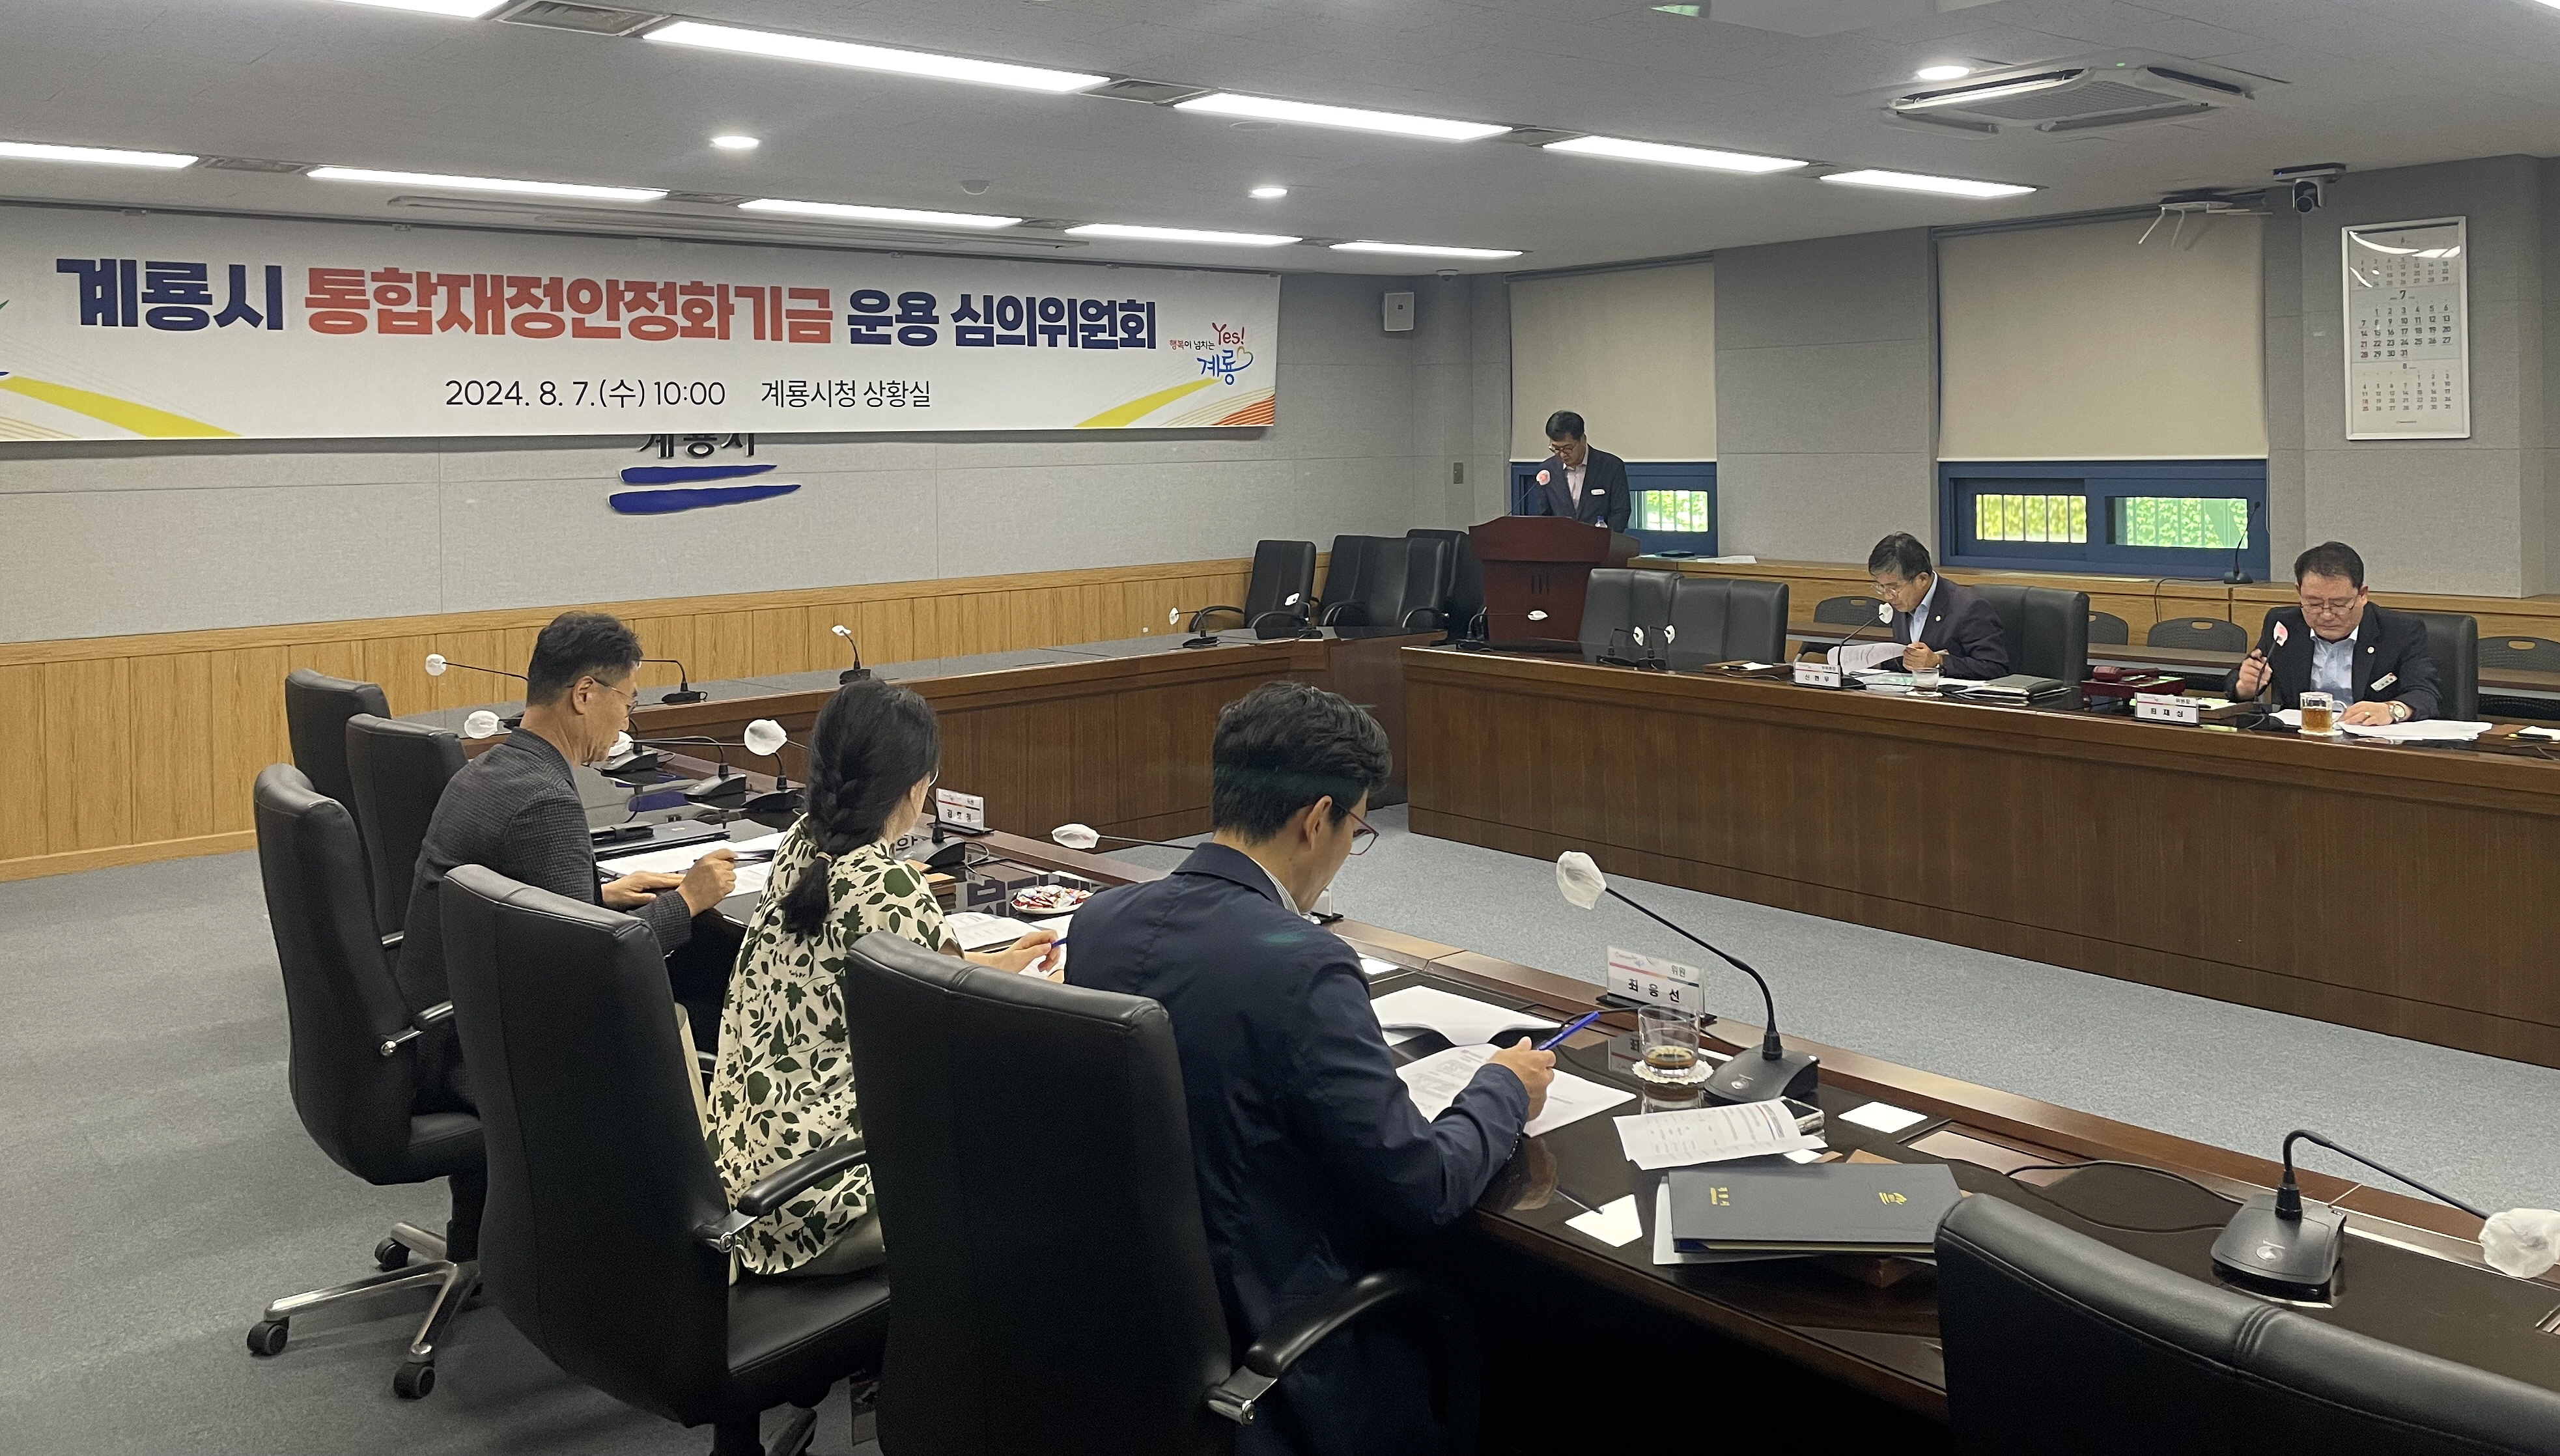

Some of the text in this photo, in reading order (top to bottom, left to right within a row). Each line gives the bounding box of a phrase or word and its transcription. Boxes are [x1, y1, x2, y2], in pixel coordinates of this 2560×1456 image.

[57, 259, 1157, 350] 계룡시 통합재정안정화기금 운용 심의위원회
[2400, 290, 2406, 299] 7
[1170, 339, 1216, 350] 행복이 넘치는
[1212, 322, 1245, 345] Yes!
[1197, 349, 1237, 385] 계룡
[445, 380, 530, 406] 2024.
[539, 381, 563, 406] 8.
[654, 381, 725, 405] 10:00
[761, 380, 856, 408] 계룡시청
[863, 380, 931, 408] 상황실
